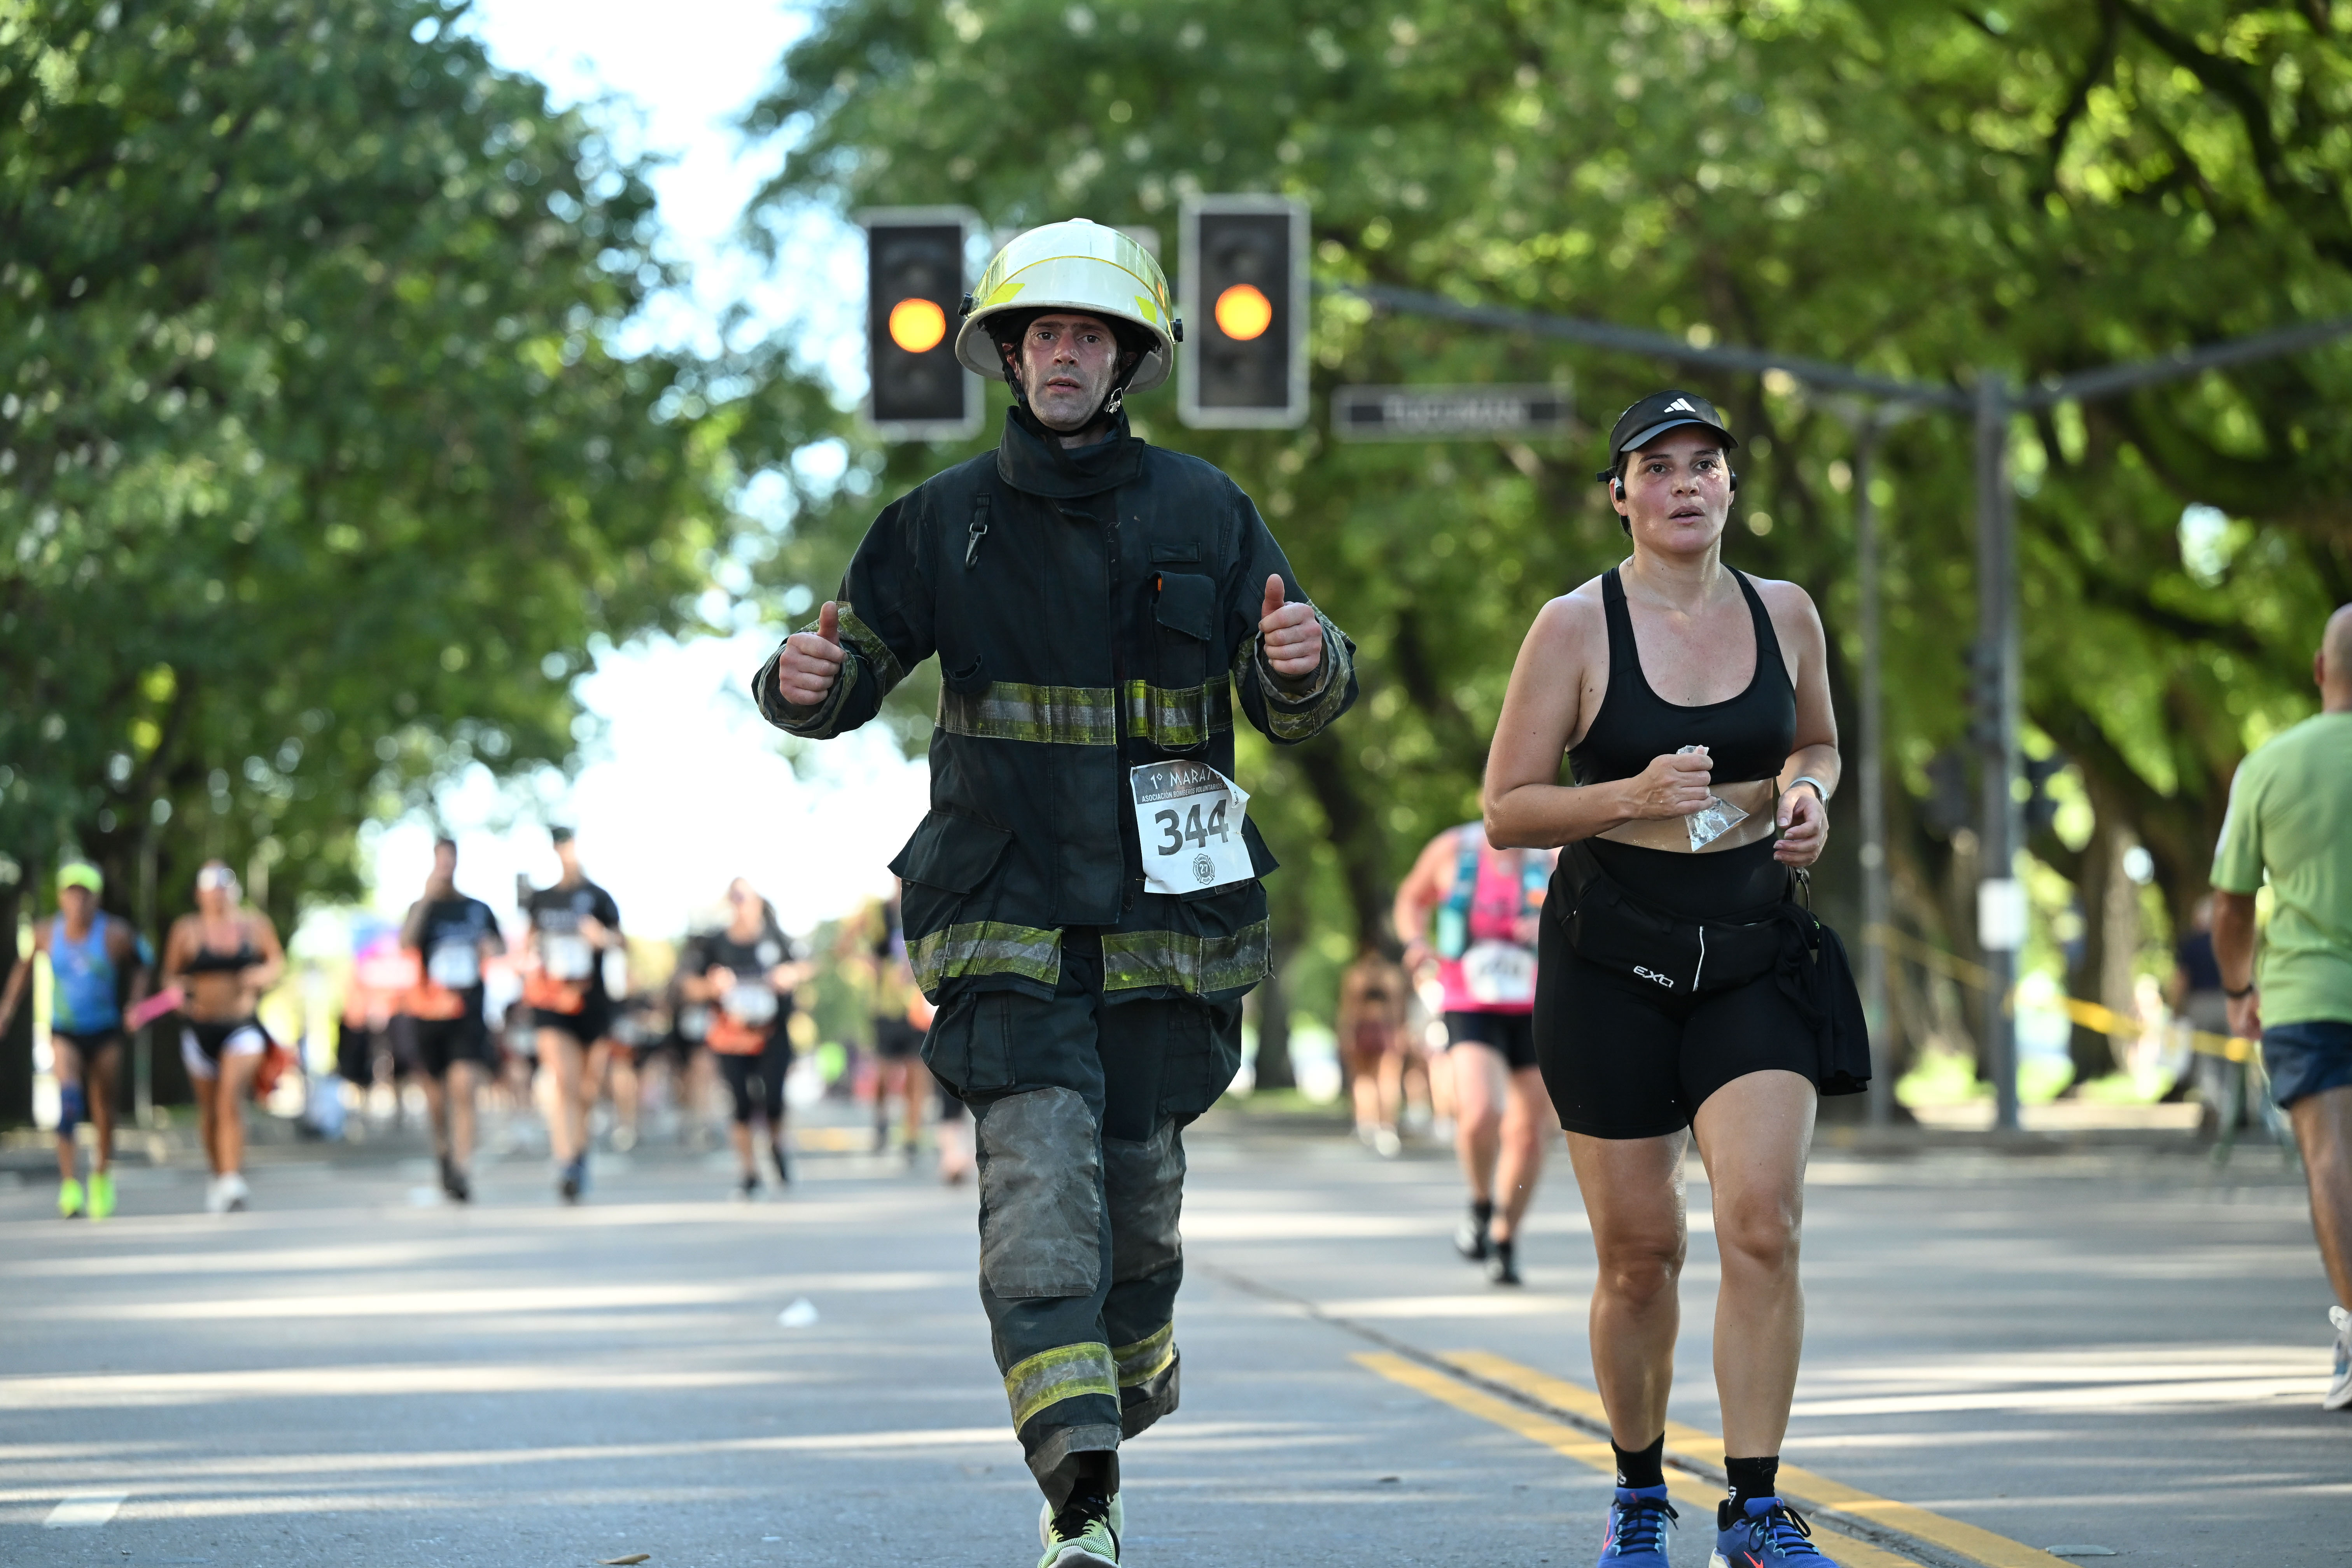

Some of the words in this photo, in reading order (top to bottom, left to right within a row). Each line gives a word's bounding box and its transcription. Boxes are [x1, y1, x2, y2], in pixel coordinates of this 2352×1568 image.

[1142, 790, 1172, 803] ASOCIACIÓN
[1173, 788, 1195, 798] BOMBEROS
[1195, 783, 1223, 793] VOLUNTARIOS
[1155, 799, 1229, 856] 344
[1199, 863, 1208, 874] 27
